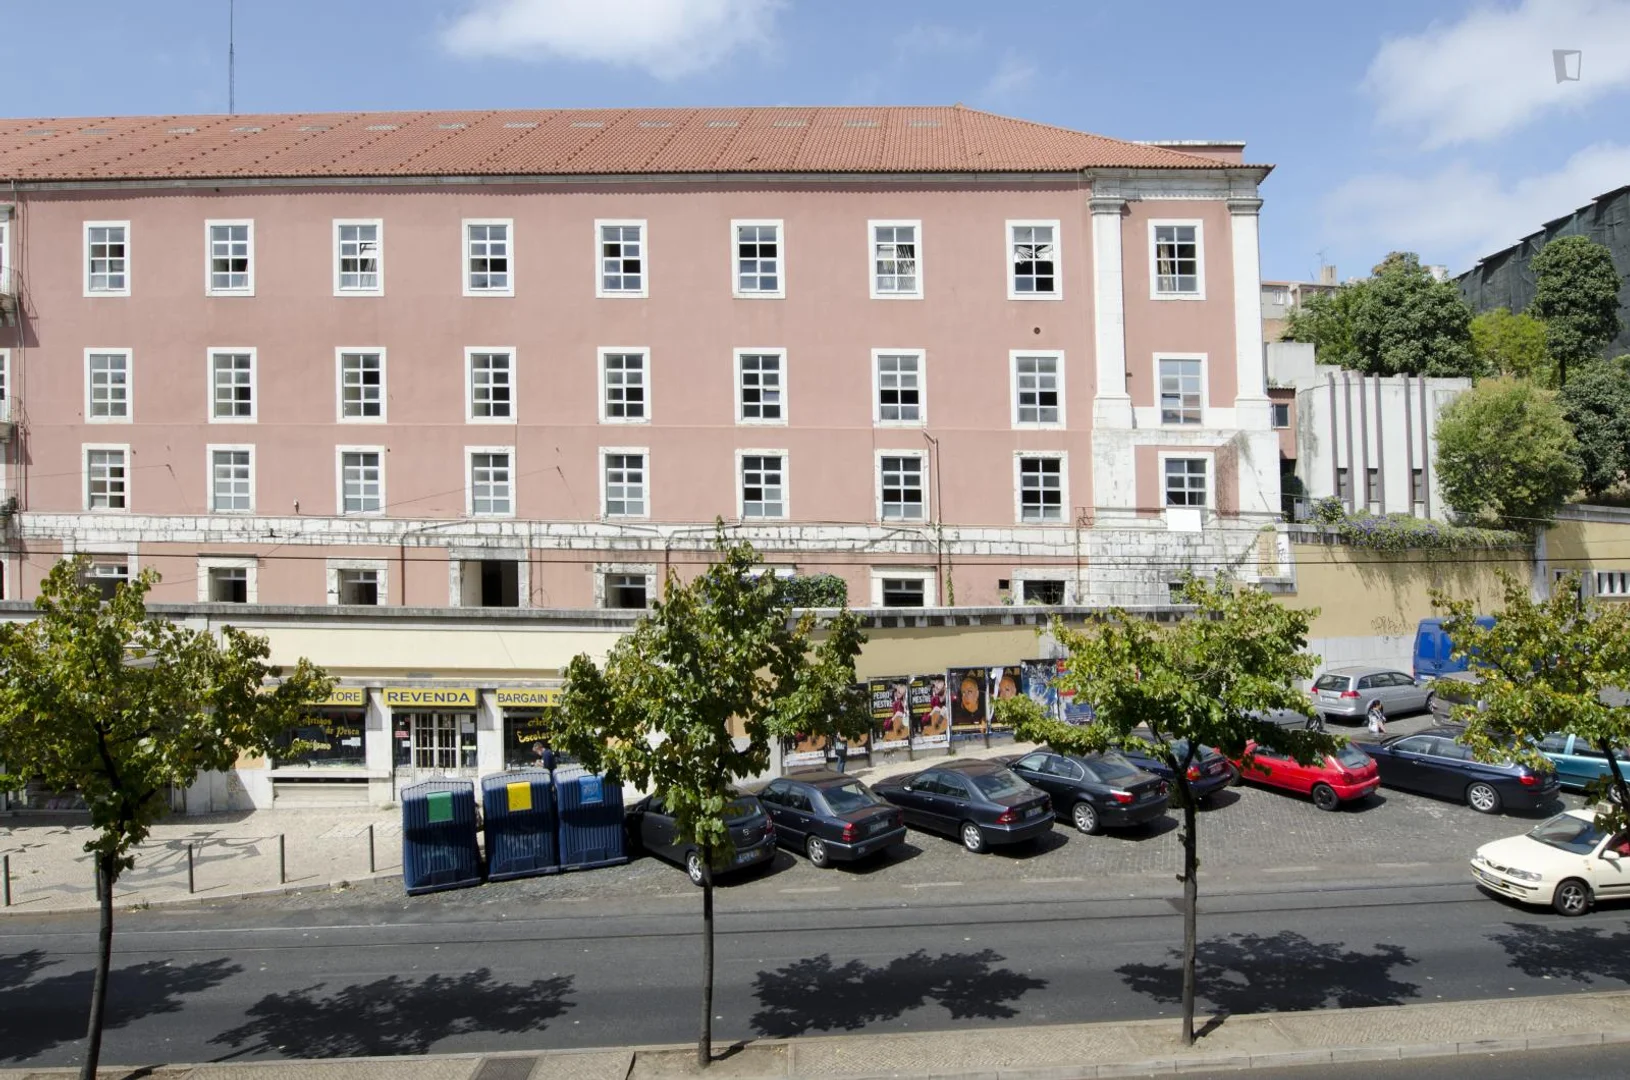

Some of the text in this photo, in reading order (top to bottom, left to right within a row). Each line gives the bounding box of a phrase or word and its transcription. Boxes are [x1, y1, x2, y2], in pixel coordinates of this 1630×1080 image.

[325, 691, 360, 702] TORE
[387, 692, 470, 702] REVENDA
[497, 693, 548, 703] BARGAIN
